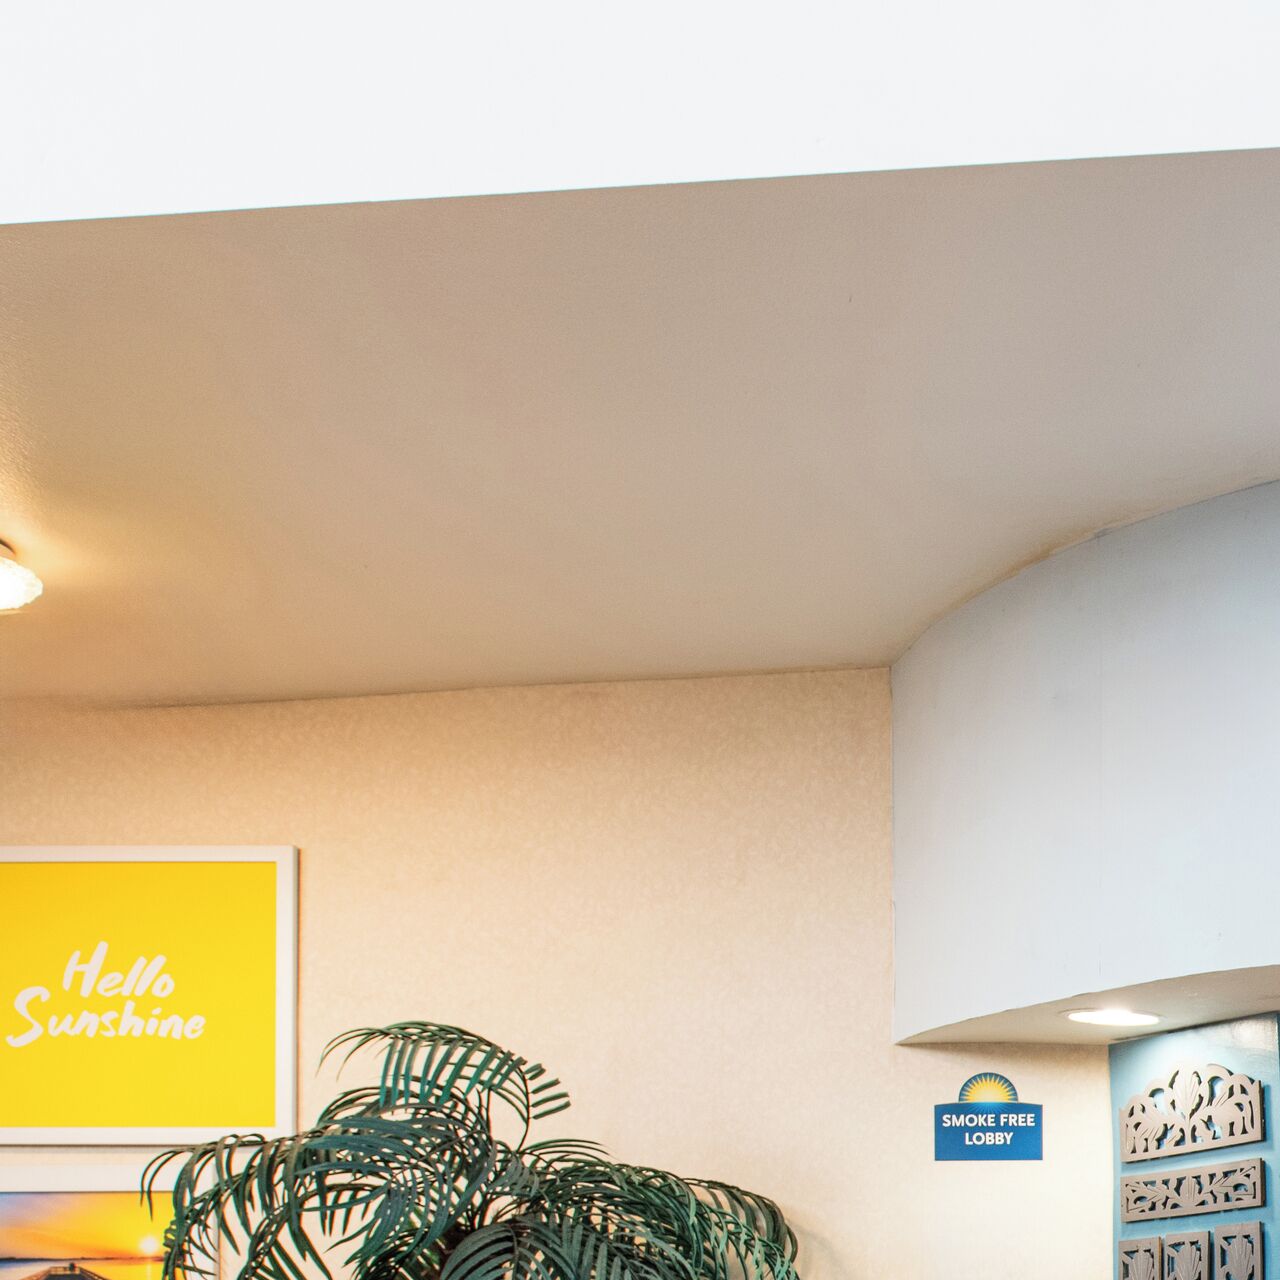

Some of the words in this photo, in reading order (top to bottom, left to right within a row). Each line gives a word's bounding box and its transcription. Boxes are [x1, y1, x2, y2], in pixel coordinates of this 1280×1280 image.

[62, 940, 175, 998] Hello
[6, 985, 206, 1048] Sunshine
[942, 1114, 996, 1127] SMOKE
[1000, 1113, 1036, 1127] FREE
[965, 1132, 1014, 1145] LOBBY
